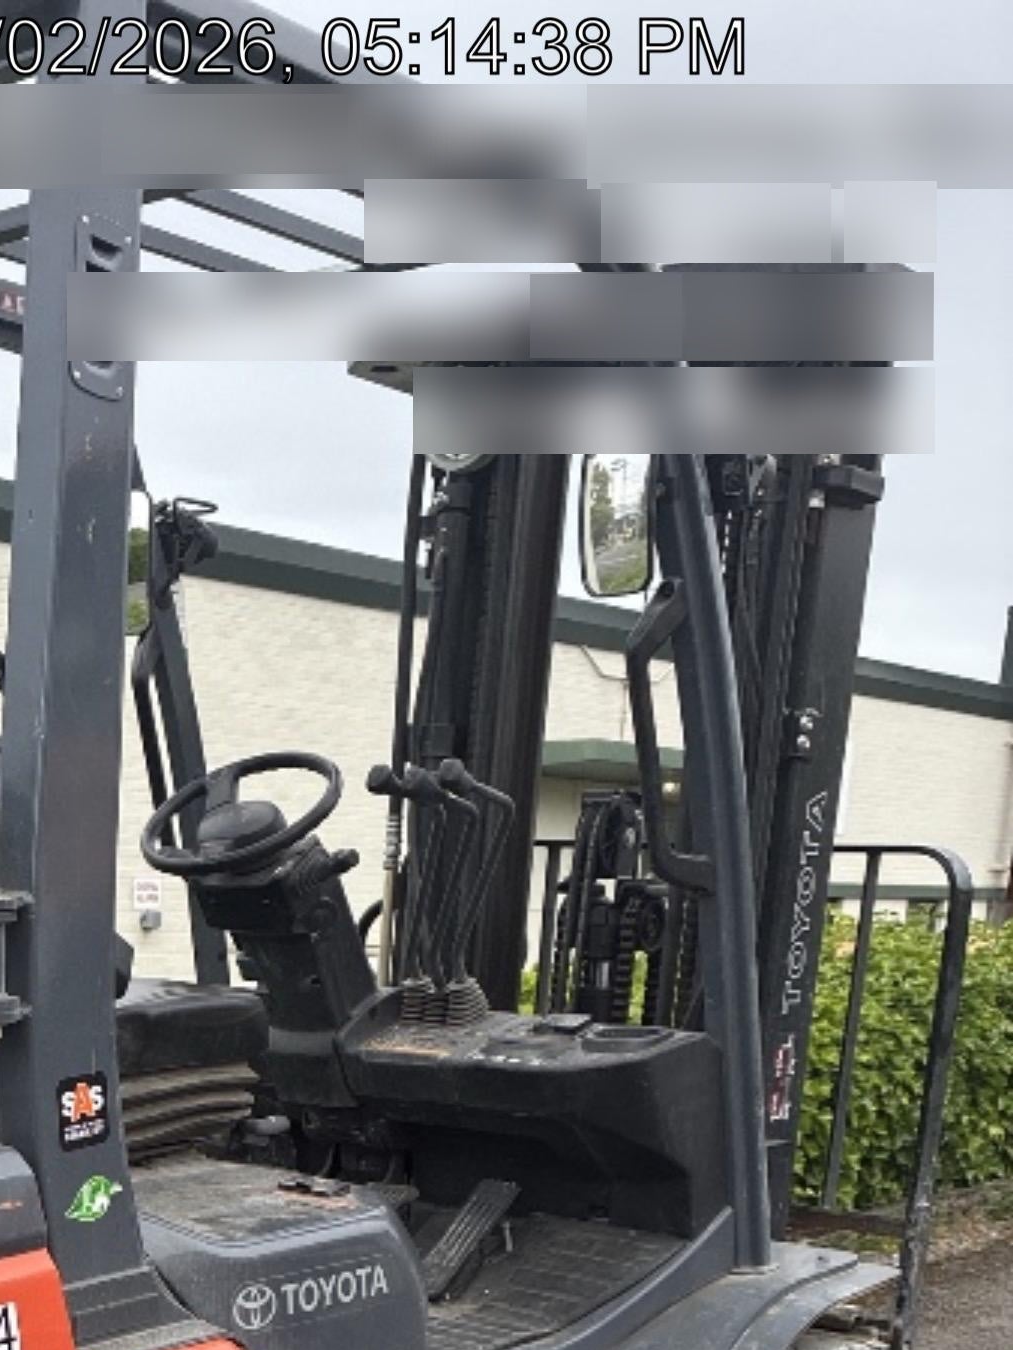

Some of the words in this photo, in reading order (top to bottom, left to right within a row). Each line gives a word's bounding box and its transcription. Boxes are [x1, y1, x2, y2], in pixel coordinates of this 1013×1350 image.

[782, 791, 829, 1016] TOYOTA
[61, 1082, 105, 1123] SAS
[281, 1264, 388, 1315] TOYOTA
